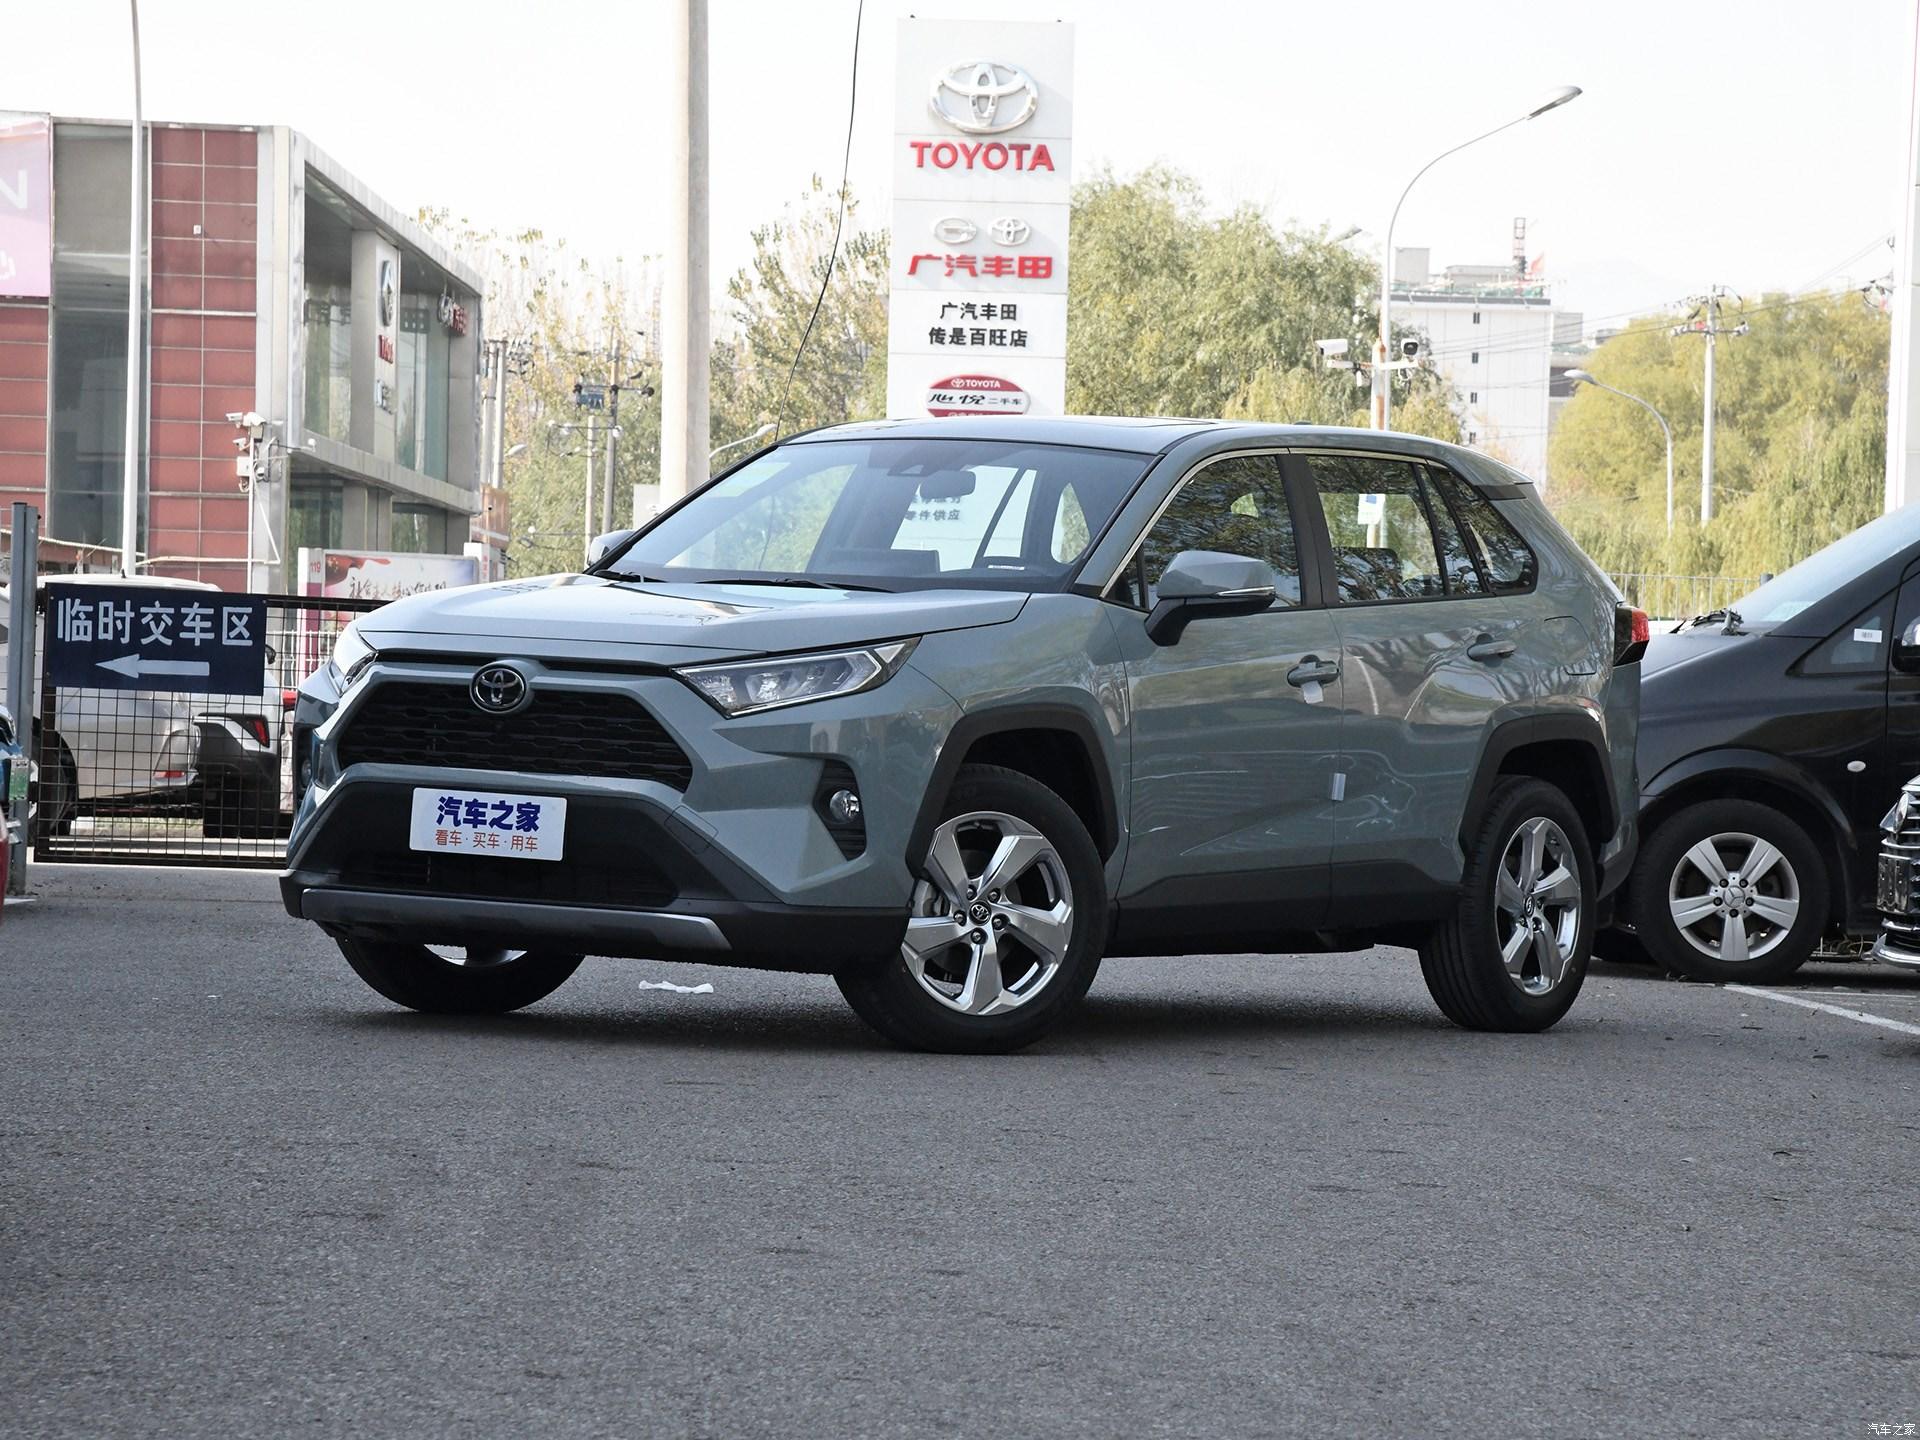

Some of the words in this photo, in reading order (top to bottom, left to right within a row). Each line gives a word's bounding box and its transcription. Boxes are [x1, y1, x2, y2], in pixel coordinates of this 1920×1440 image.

[910, 141, 1055, 172] TOYOTA
[907, 254, 1053, 279] 广汽丰田
[940, 302, 1017, 321] 广汽丰田
[965, 379, 1001, 389] TOYOTA
[57, 597, 254, 647] 临时交车区
[436, 796, 541, 832] 汽车之家
